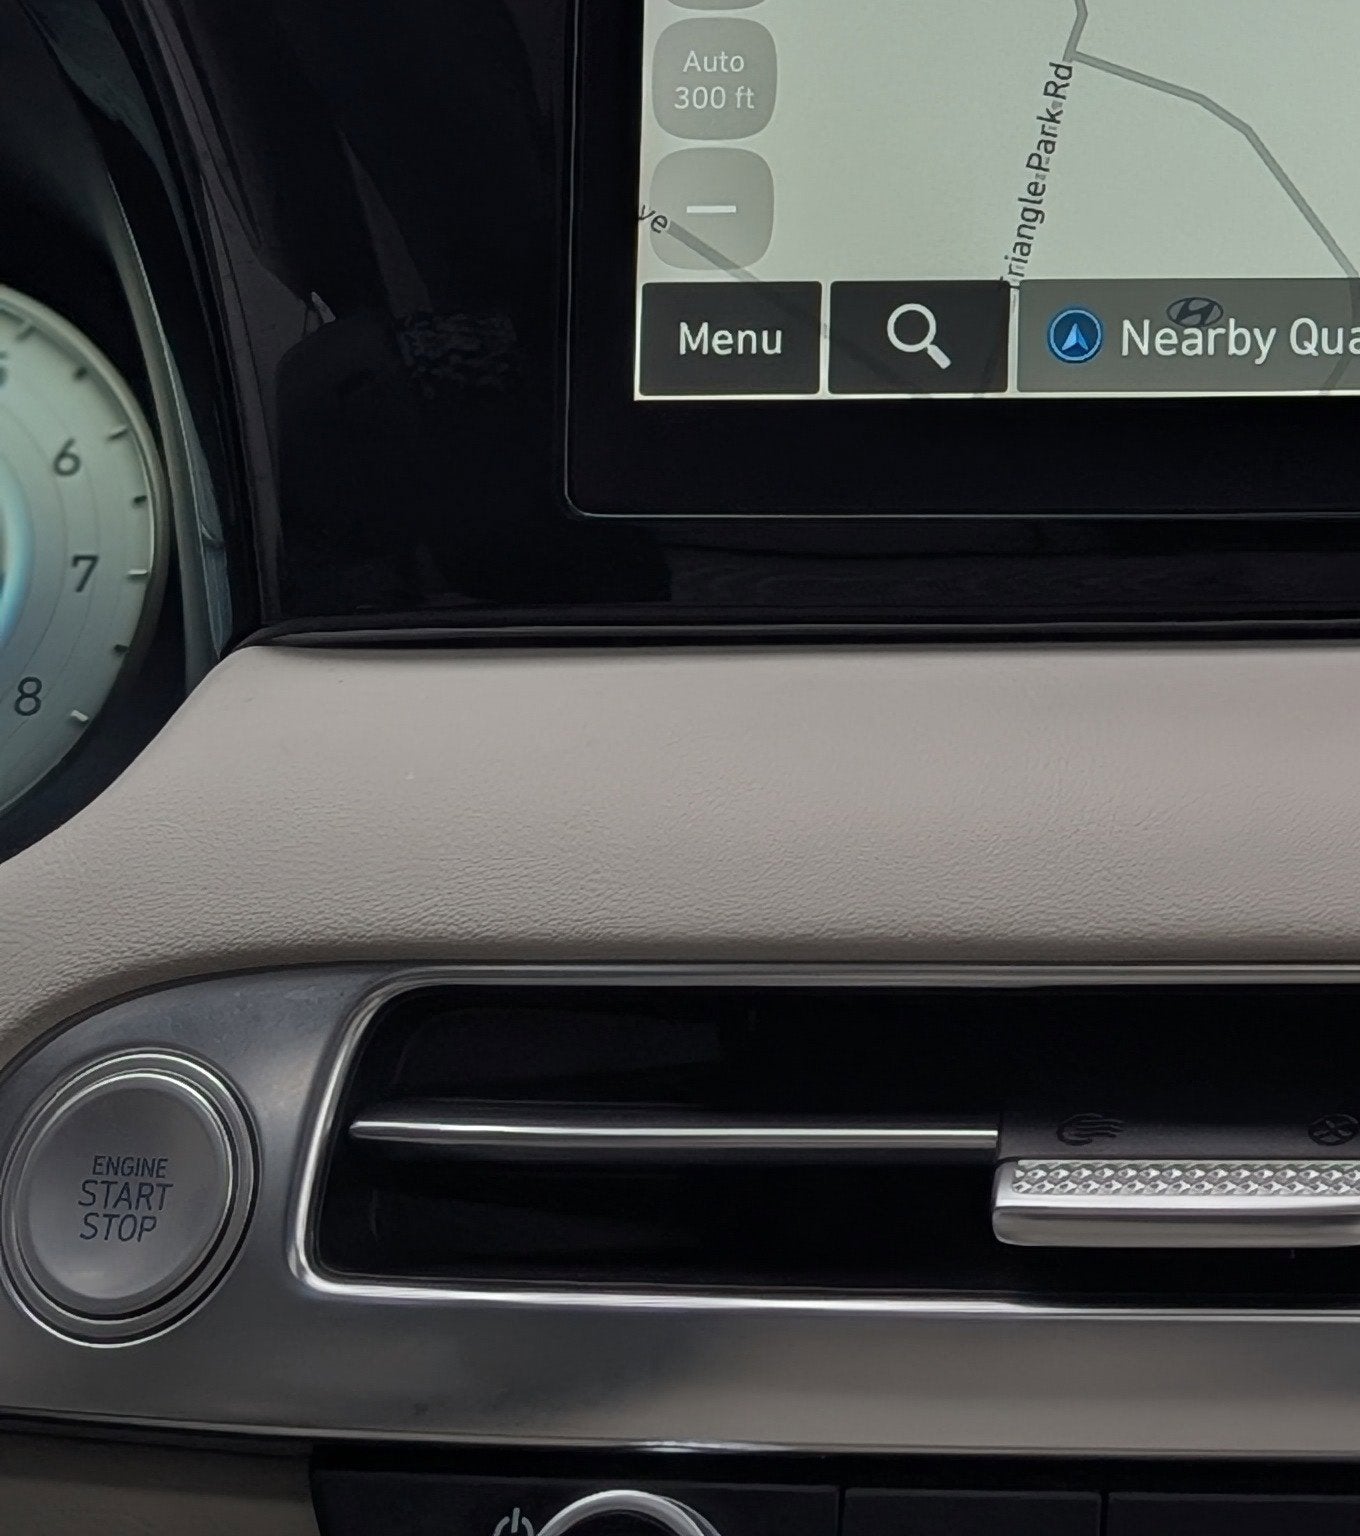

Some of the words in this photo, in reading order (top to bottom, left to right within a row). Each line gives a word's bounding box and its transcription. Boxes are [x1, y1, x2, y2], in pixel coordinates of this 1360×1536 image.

[682, 50, 746, 74] Auto
[673, 86, 727, 110] 300
[736, 84, 756, 110] ft
[1042, 61, 1074, 101] Rd
[1024, 107, 1065, 173] Park
[638, 204, 668, 234] ve
[679, 322, 783, 356] Menu
[1120, 317, 1277, 365] Nearby
[54, 438, 82, 477] 6
[70, 554, 99, 594] 7
[13, 676, 43, 717] 8
[91, 1155, 169, 1178] ENGINE
[77, 1179, 174, 1211] START
[79, 1212, 157, 1242] STOP
